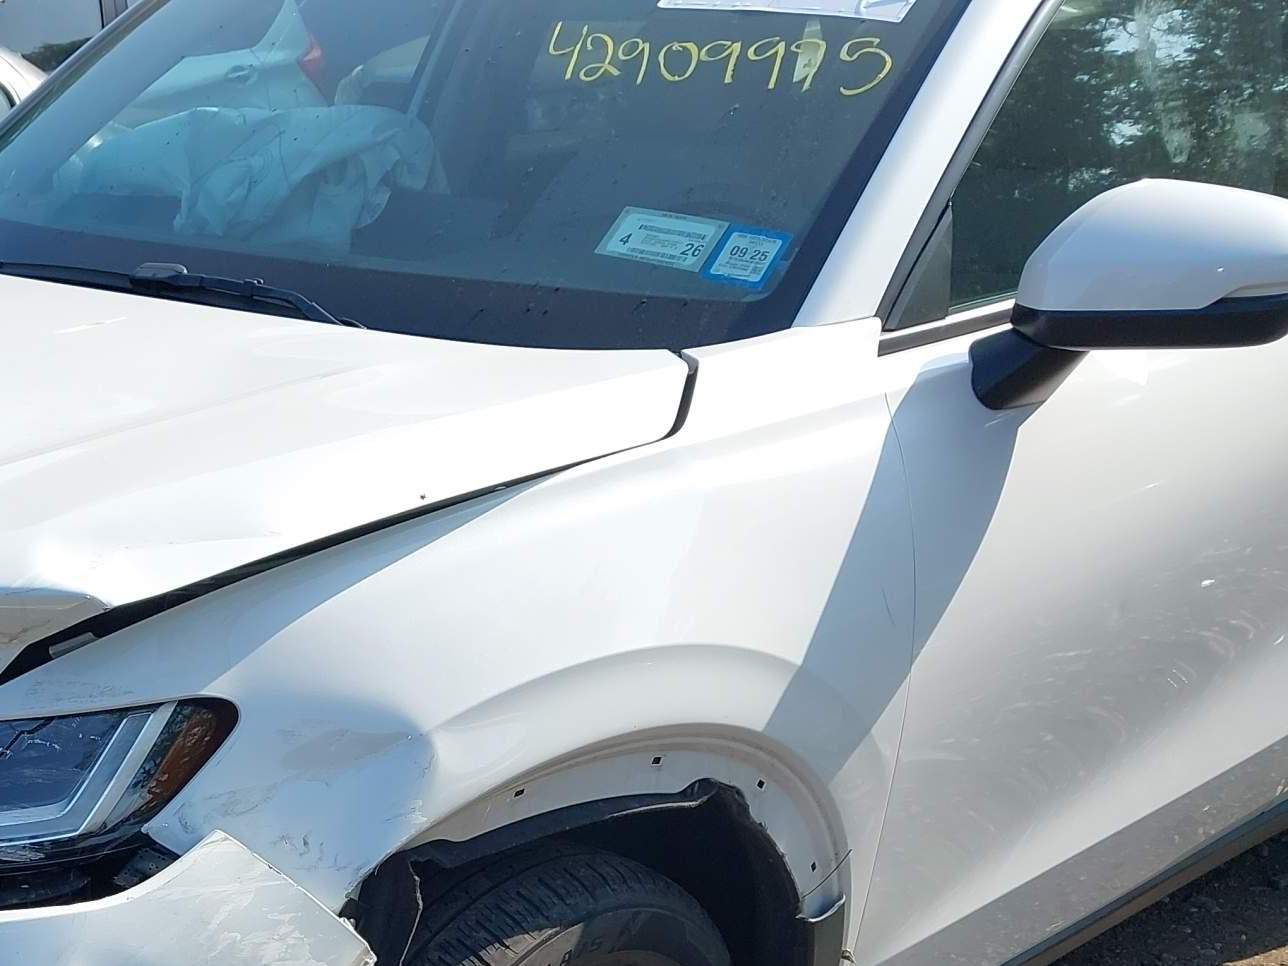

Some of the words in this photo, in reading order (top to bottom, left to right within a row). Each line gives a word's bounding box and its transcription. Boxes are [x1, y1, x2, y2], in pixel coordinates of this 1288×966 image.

[618, 232, 634, 246] 4
[679, 242, 705, 258] 26
[729, 244, 748, 259] 09
[749, 249, 771, 263] 25
